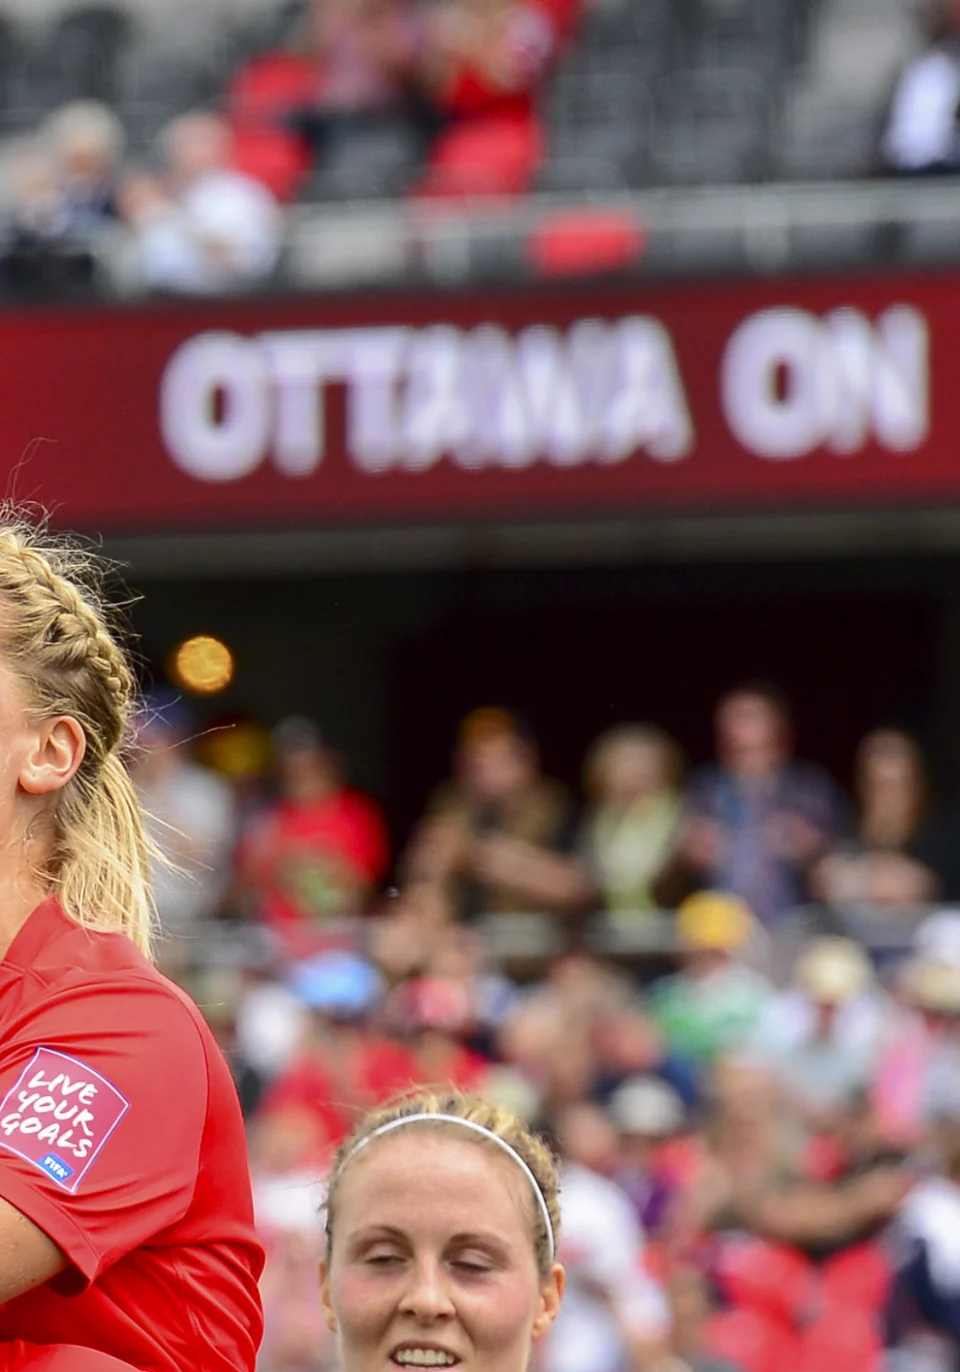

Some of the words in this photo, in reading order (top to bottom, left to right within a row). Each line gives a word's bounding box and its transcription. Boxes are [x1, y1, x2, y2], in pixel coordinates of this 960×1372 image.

[159, 316, 693, 481] OTTAWA
[720, 305, 929, 458] ON
[28, 1070, 98, 1105] LIVE
[0, 1112, 93, 1158] GOALS
[18, 1090, 94, 1136] YOUR
[43, 1156, 68, 1178] FIFA
